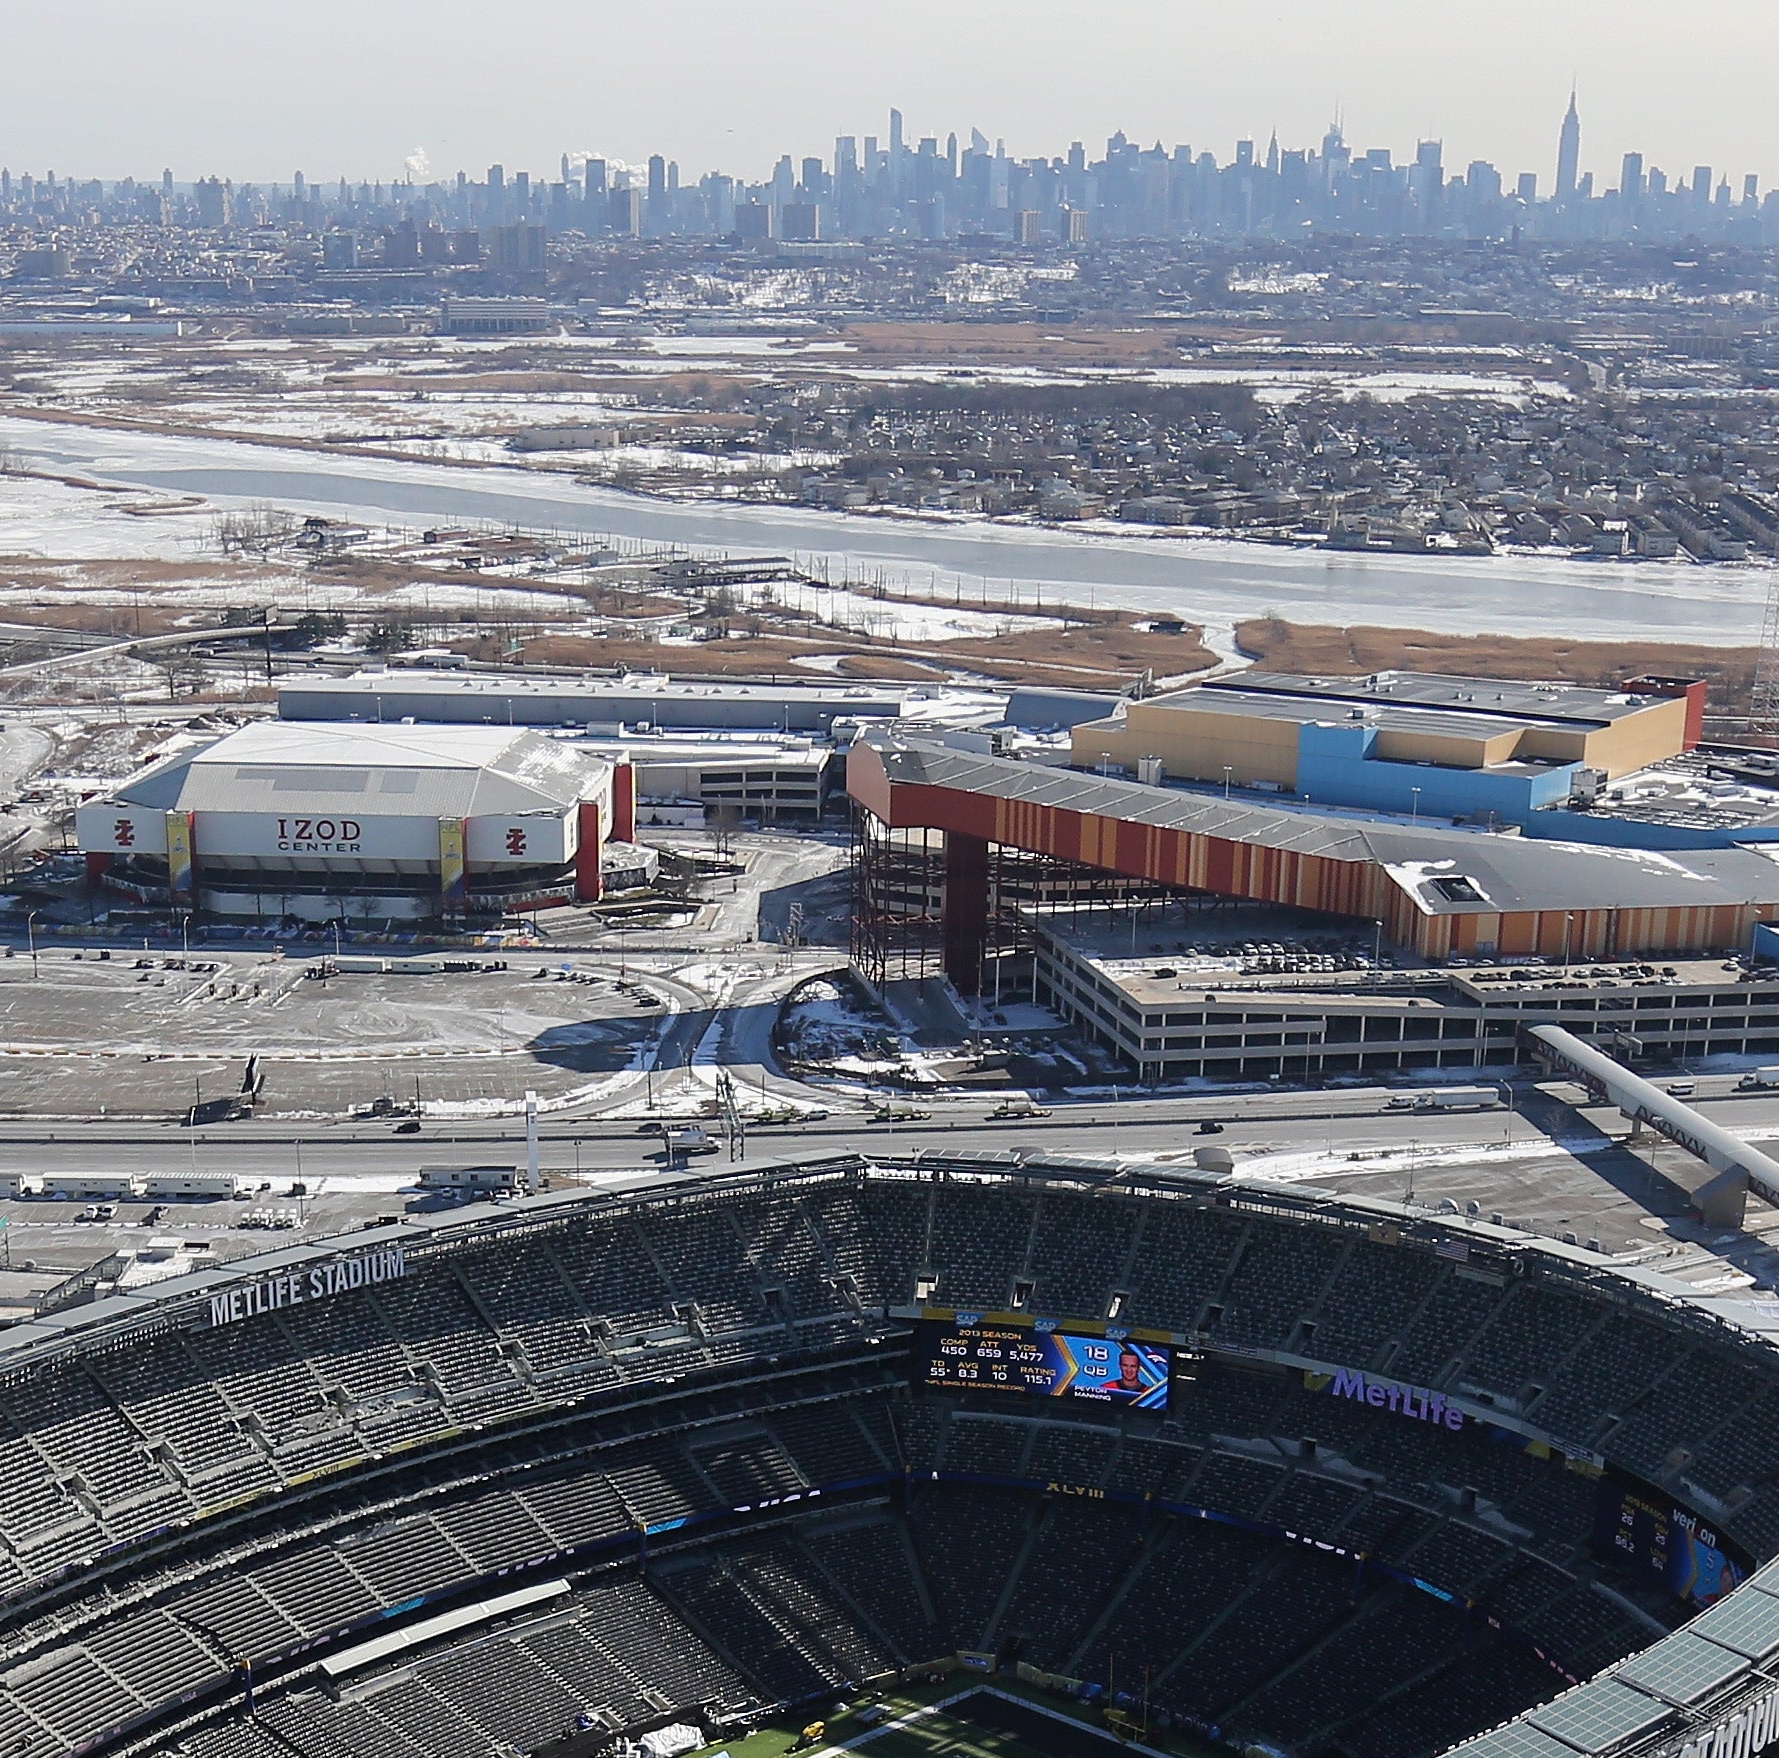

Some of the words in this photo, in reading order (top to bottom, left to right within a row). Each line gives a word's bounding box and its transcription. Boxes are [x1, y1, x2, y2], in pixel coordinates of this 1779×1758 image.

[278, 819, 362, 841] IZOD
[278, 842, 362, 852] CENTER
[210, 1274, 303, 1327] METLIFE
[309, 1249, 405, 1299] STADIUM
[956, 1315, 978, 1326] SAP
[1034, 1320, 1056, 1332] SAP
[982, 1331, 1022, 1340] SEASON
[1106, 1328, 1127, 1340] SAP
[940, 1338, 969, 1346] COMP
[941, 1346, 967, 1356] 450
[977, 1348, 1002, 1358] 659
[1084, 1345, 1109, 1361] 18
[958, 1362, 979, 1370] AVG
[992, 1364, 1008, 1372] INT
[1021, 1366, 1056, 1376] RATING
[1084, 1365, 1108, 1377] QB
[992, 1372, 1007, 1381] 10
[1025, 1375, 1052, 1385] 115.1
[1332, 1368, 1464, 1431] MetLife
[1046, 1481, 1105, 1499] XLVIII
[1673, 1509, 1716, 1548] verion
